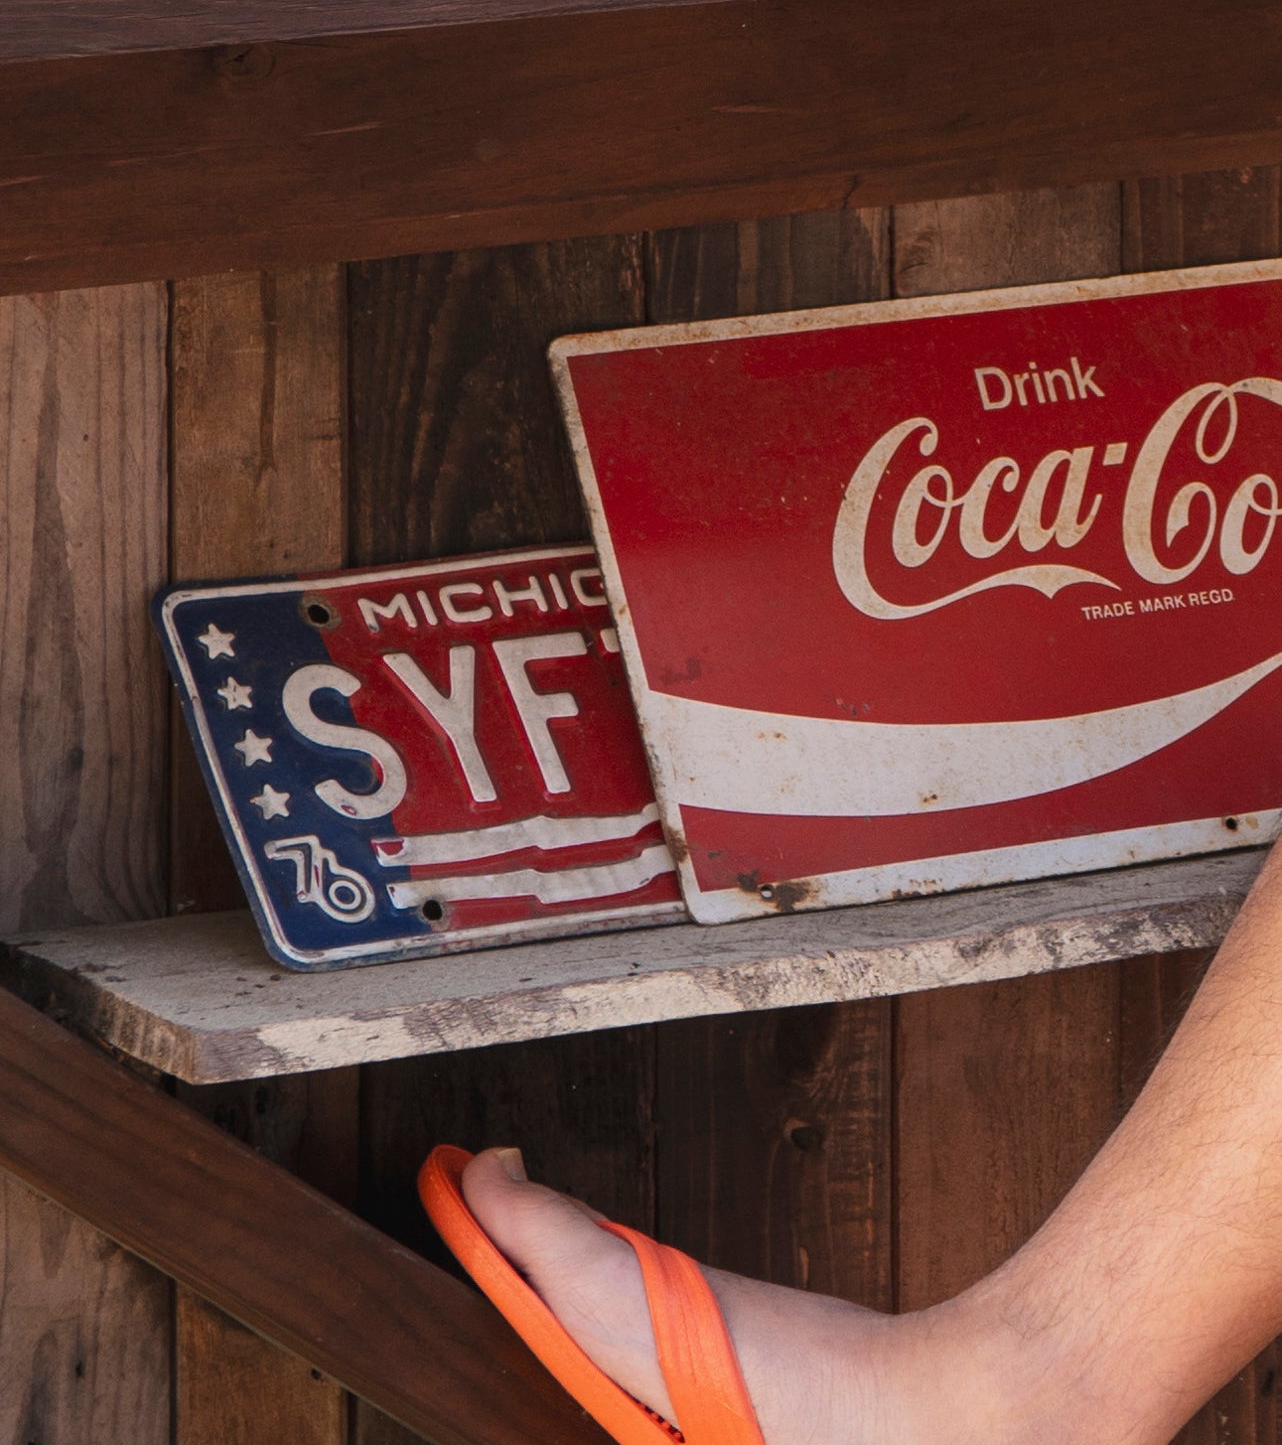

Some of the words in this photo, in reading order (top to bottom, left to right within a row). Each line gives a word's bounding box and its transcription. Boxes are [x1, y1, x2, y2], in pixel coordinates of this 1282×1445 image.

[974, 357, 1106, 412] Drink
[1081, 600, 1136, 621] TRADE
[1138, 594, 1187, 614] MARK
[282, 628, 620, 820] SYF
[264, 835, 376, 924] 76
